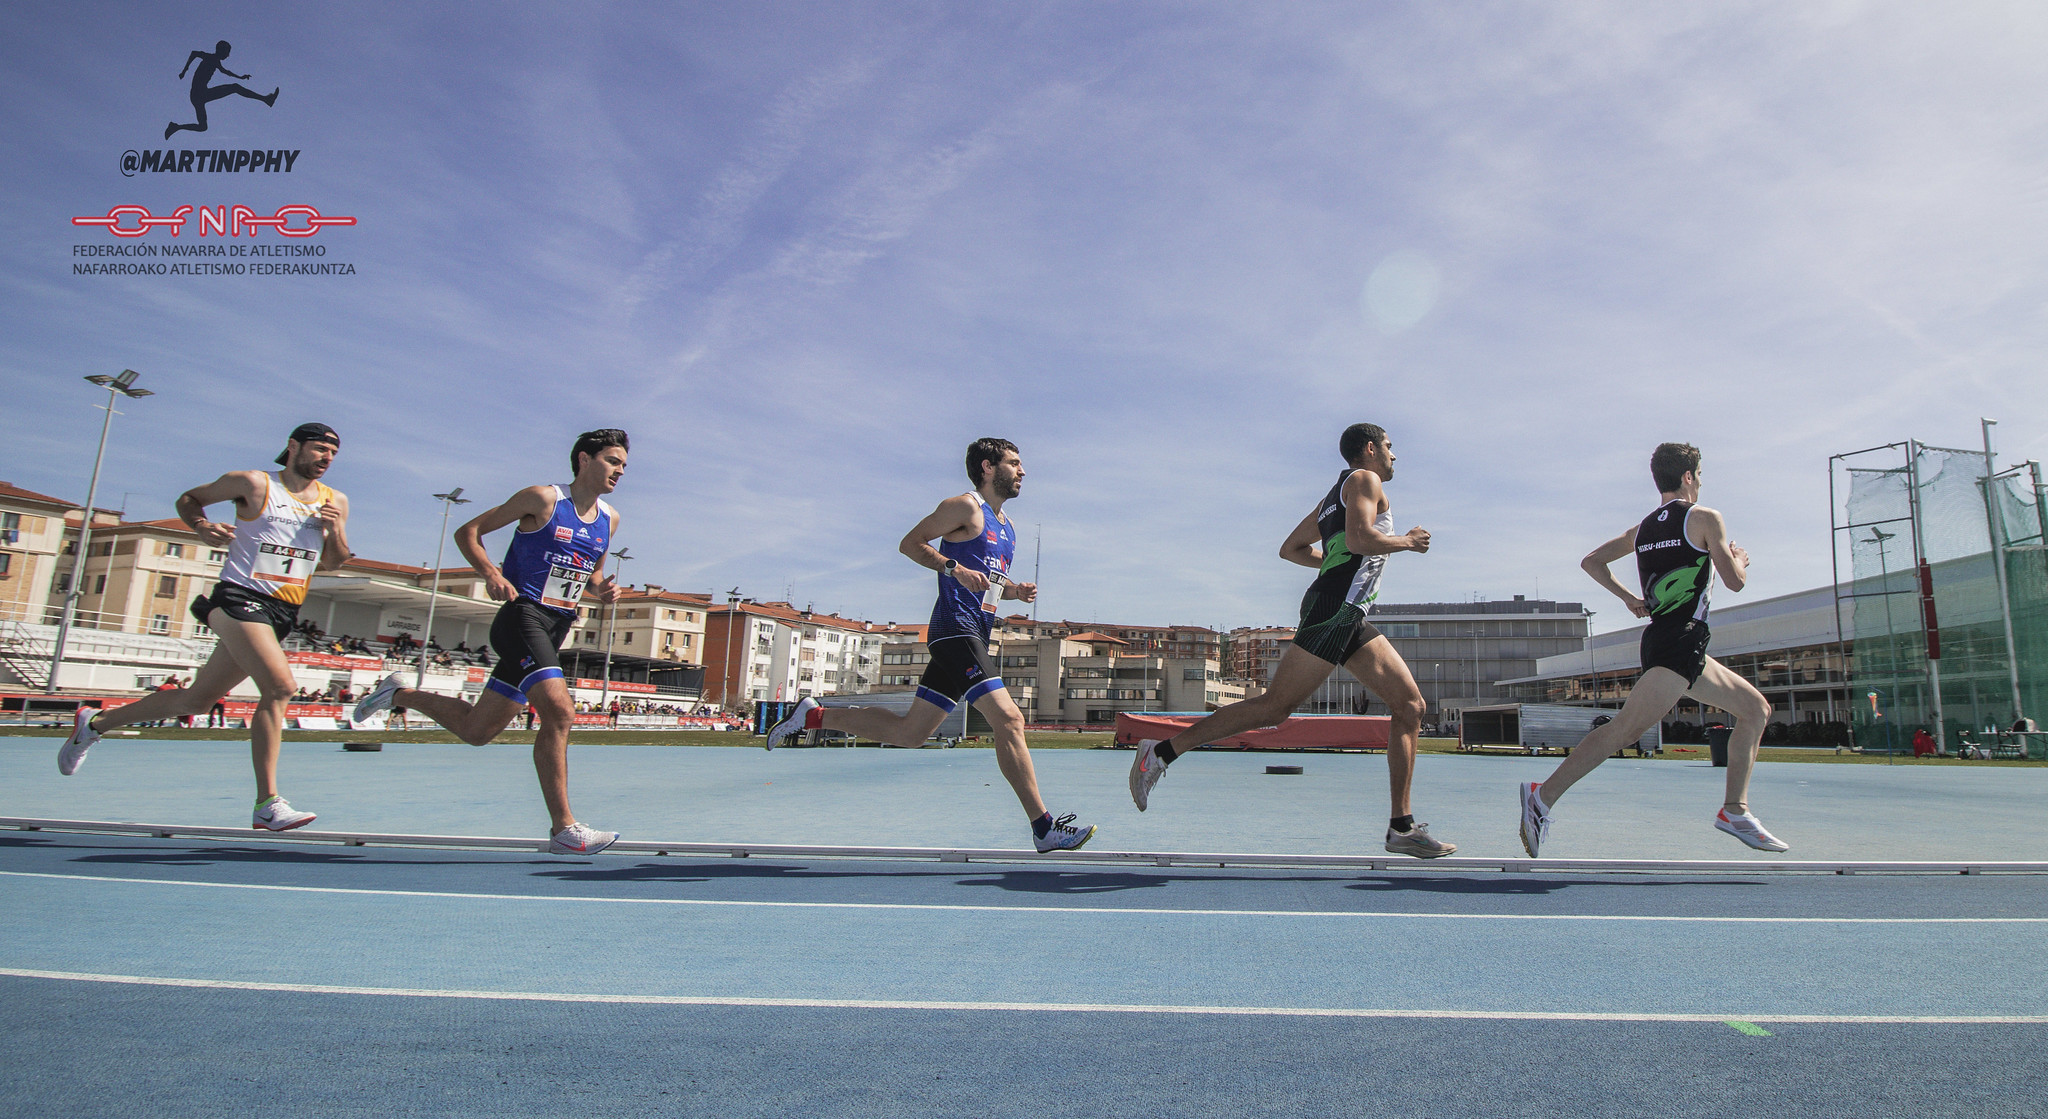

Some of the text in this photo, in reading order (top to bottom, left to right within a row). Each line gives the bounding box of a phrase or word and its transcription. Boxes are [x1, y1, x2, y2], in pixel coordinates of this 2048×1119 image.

[281, 558, 293, 574] 1
[560, 581, 582, 599] 12
[387, 620, 422, 632] LARRABIDE
